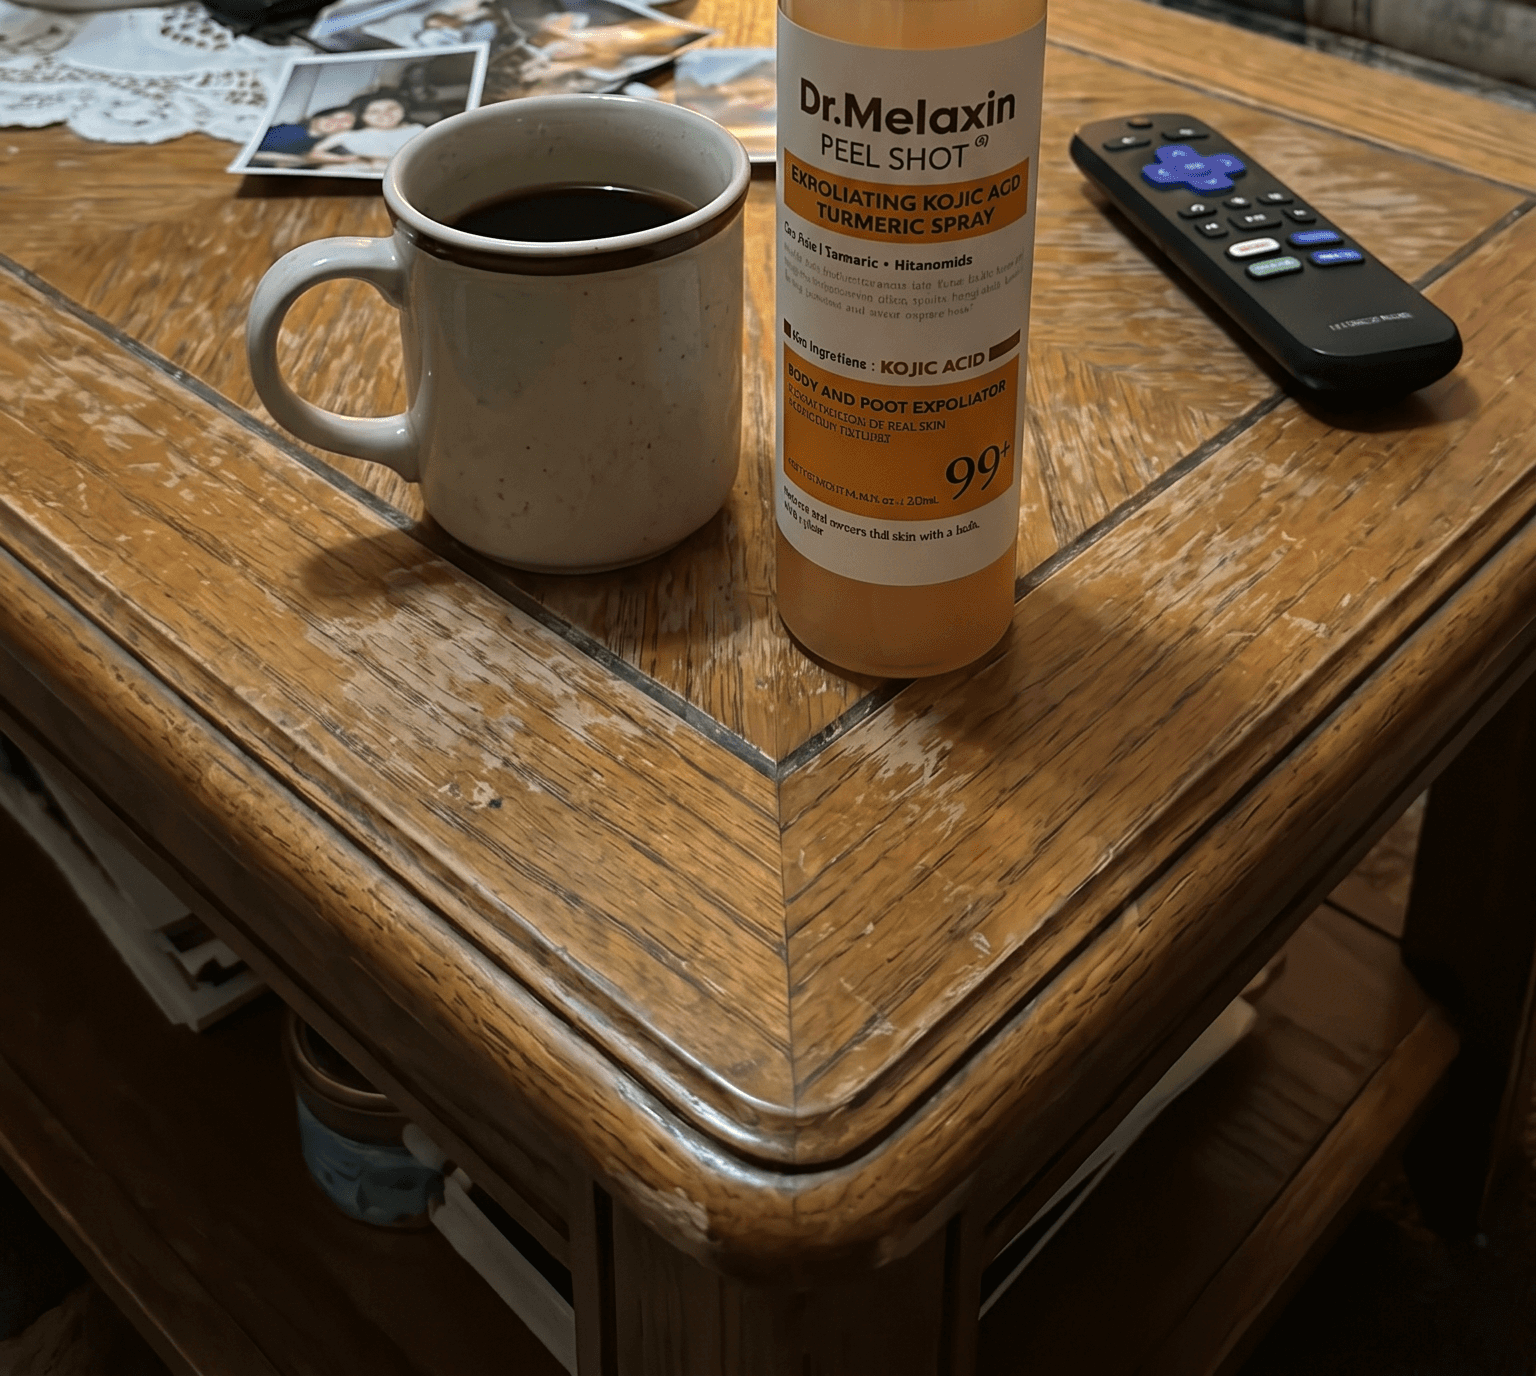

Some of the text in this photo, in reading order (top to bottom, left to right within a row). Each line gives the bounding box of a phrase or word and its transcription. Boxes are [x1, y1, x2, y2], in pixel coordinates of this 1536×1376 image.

[800, 77, 1015, 135] Dr.Melaxin
[821, 133, 969, 171] PEEL SHOT
[923, 188, 984, 212] KOJIC
[816, 201, 995, 235] TURMERIC SPRAY
[895, 254, 973, 272] Hitanomids
[880, 360, 938, 378] KOJIC
[942, 352, 985, 374] ACID
[788, 363, 819, 392] BODY
[821, 385, 856, 407] AND
[860, 396, 908, 414] POOT
[912, 379, 1007, 415] EXPOLIATOR
[869, 419, 885, 430] DE
[888, 421, 917, 432] REAL
[919, 420, 947, 432] SKIN
[892, 529, 917, 542] skin
[919, 525, 944, 541] with
[946, 528, 953, 537] a
